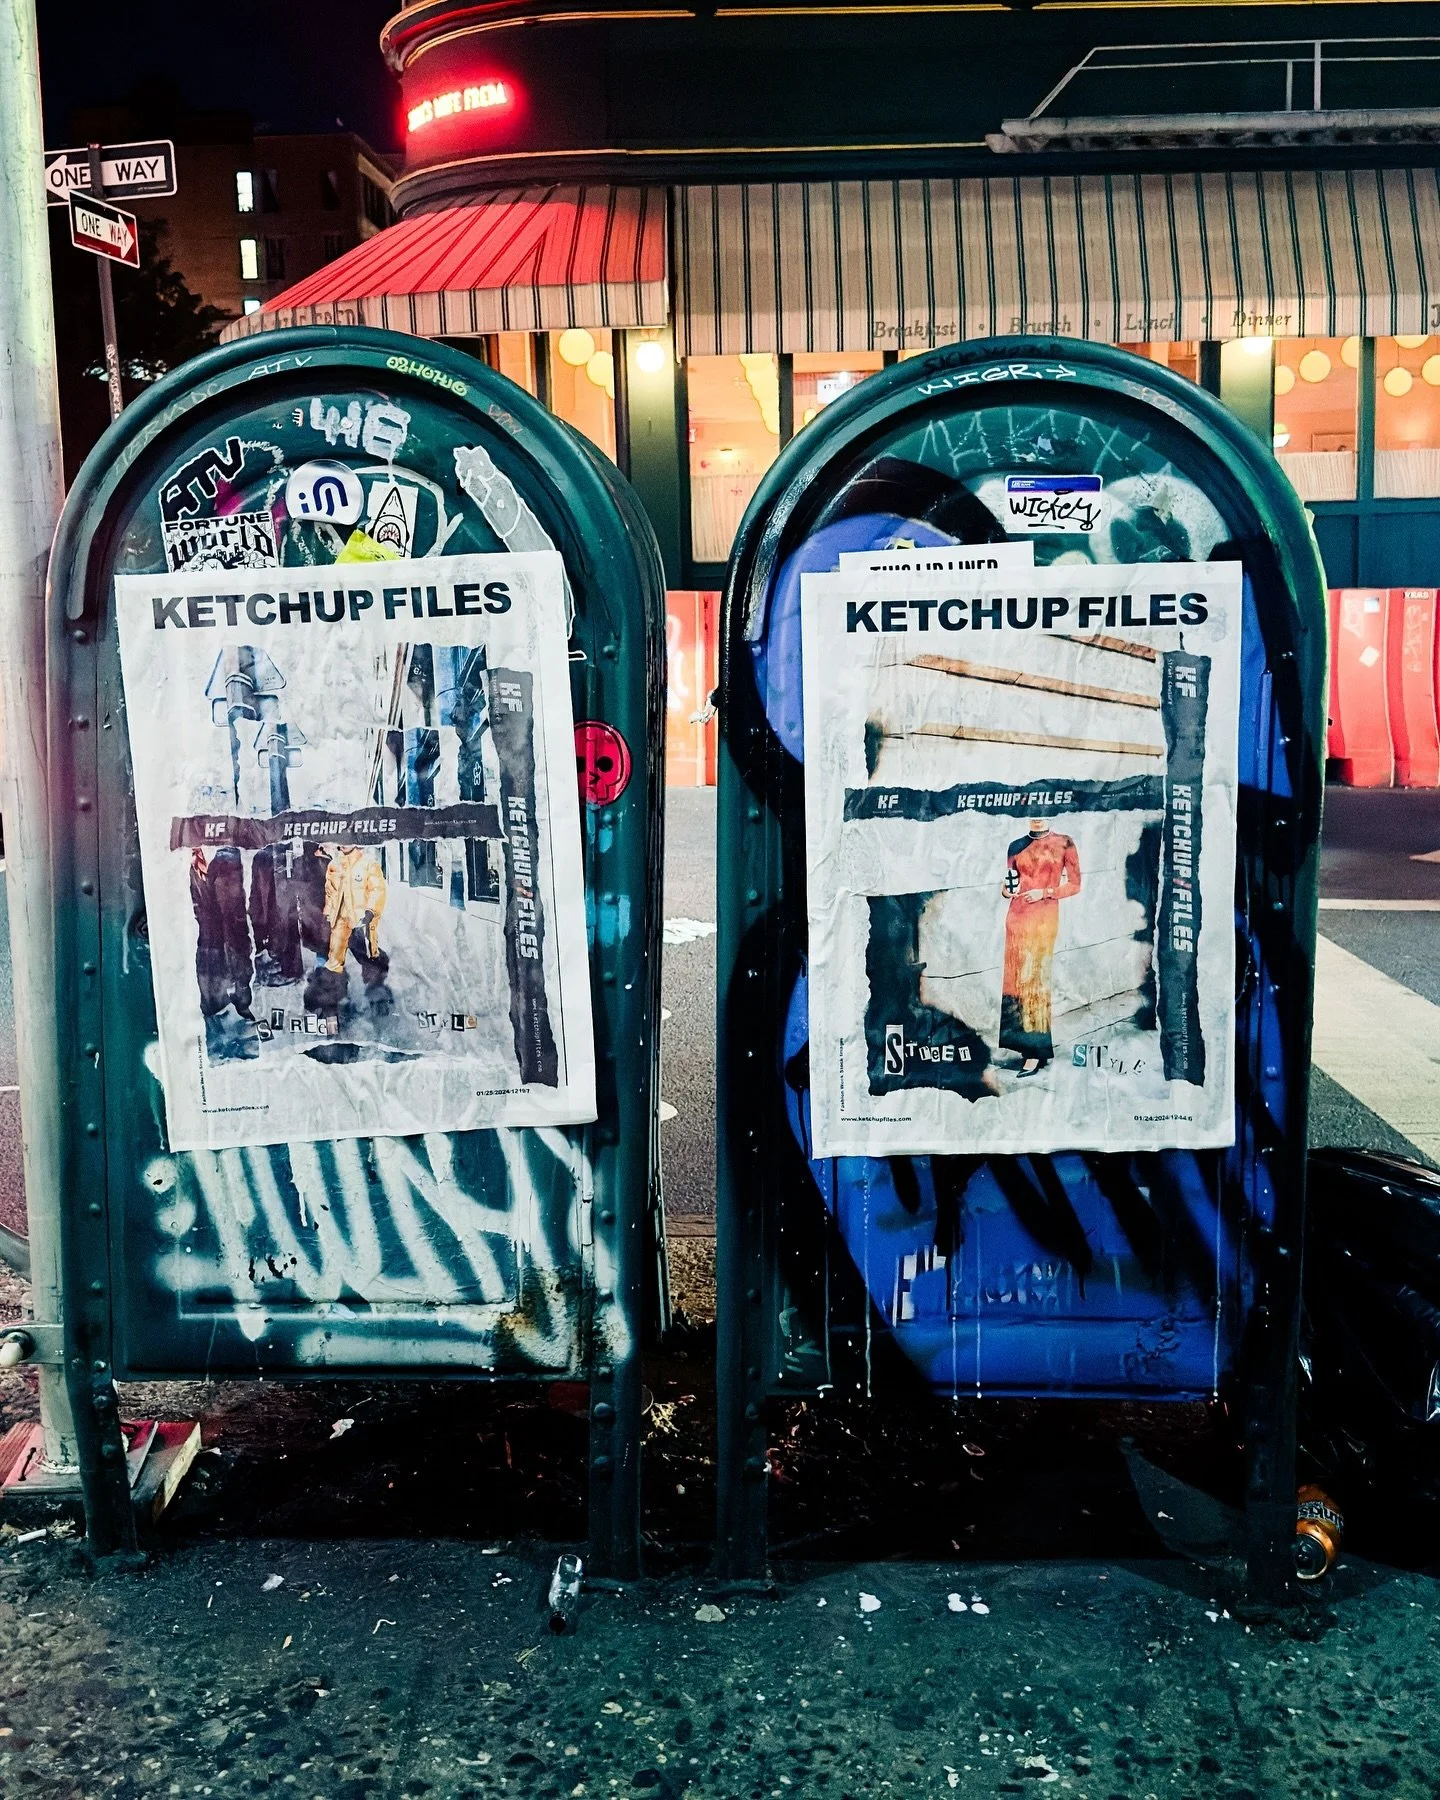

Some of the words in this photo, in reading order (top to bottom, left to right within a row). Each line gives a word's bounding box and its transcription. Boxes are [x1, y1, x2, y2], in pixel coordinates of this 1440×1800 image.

[50, 167, 91, 187] ONE
[115, 159, 159, 181] WAY
[81, 212, 102, 237] ONE
[109, 223, 128, 246] WAY
[873, 320, 957, 340] Breakfast
[1008, 314, 1071, 334] Brunch
[1124, 312, 1176, 330] Lunch
[1231, 311, 1292, 327] Dinner
[247, 355, 312, 380] ATV
[165, 512, 270, 533] FORTUNE
[152, 588, 373, 629] KETCHUP
[384, 581, 511, 619] FILES
[846, 597, 1068, 633] KETCHUP
[1078, 592, 1209, 628] FILES
[1174, 665, 1197, 697] KF
[499, 682, 522, 712] KF
[877, 794, 899, 809] KF
[204, 822, 226, 837] KF
